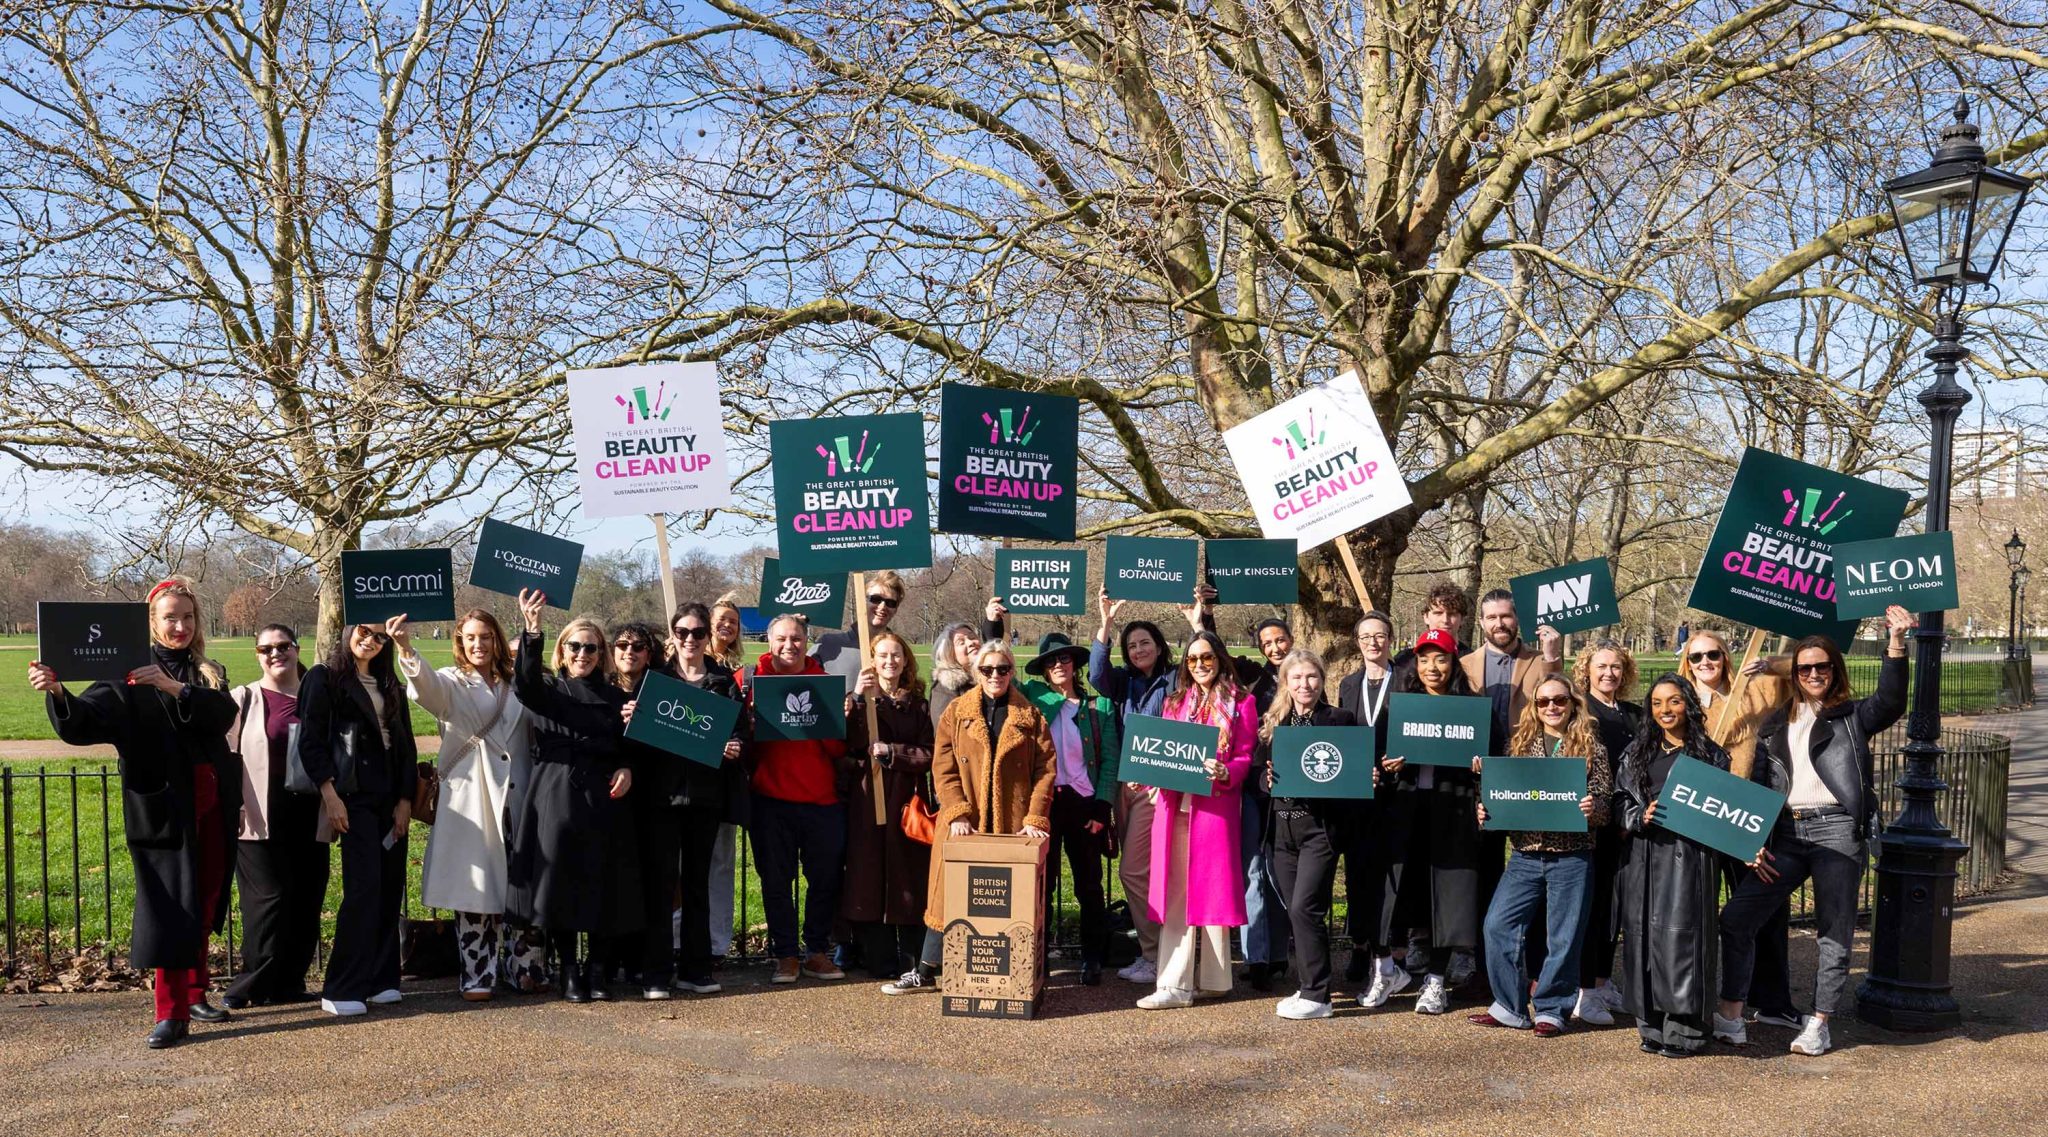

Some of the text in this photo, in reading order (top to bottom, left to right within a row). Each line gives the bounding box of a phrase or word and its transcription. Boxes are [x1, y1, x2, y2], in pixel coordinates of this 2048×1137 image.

[626, 428, 654, 436] GREAT
[605, 434, 696, 458] BEAUTY
[1017, 452, 1049, 460] BRITISH
[596, 454, 711, 479] CLEAN UP
[966, 456, 1052, 480] BEAUTY
[1274, 446, 1358, 499] BEAUTY
[859, 479, 894, 487] BRITISH
[955, 475, 1062, 501] CLEAN UP
[1273, 476, 1348, 520] CLEAN
[1348, 461, 1378, 486] UP
[804, 488, 899, 511] BEAUTY
[793, 508, 912, 533] CLEAN UP
[1296, 514, 1327, 532] SUSTAINABLE
[1328, 506, 1347, 516] BEAUTY
[1347, 494, 1374, 508] COALITION
[1754, 523, 1832, 552] THE GREAT BRIT
[1138, 558, 1165, 568] BAIE
[1742, 532, 1834, 578] BEAUT
[515, 565, 546, 577] PROVENCE
[1011, 560, 1070, 572] BRITISH
[1244, 568, 1295, 576] KINGSLEY
[1846, 555, 1942, 586] NEOM
[354, 568, 442, 592] scrummi
[1120, 569, 1183, 581] BOTANIQUE
[1723, 551, 1837, 603] CLEAN U
[775, 577, 830, 606] Boots
[1011, 577, 1070, 590] BEAUTY
[1848, 581, 1943, 596] WELLBEING LONDON
[1537, 573, 1592, 616] MY
[1751, 586, 1782, 598] POWERED
[1010, 594, 1070, 607] COUNCIL
[1730, 586, 1823, 620] SUSTAINABLE BEAUTY COALITION
[1536, 604, 1600, 624] MYGROUP
[781, 712, 818, 724] Earthy
[1403, 722, 1474, 740] BRAIDS GANG
[1132, 735, 1206, 762] MZ SKIN
[1325, 746, 1339, 760] YARD
[1151, 759, 1178, 769] MARYAM
[1178, 763, 1203, 774] ZAMANI
[1306, 766, 1338, 779] REMEDIES
[1671, 784, 1764, 833] ELEMIS
[973, 879, 1007, 887] BRITISH
[973, 898, 1006, 906] COUNCIL
[972, 939, 1005, 947] RECYCLE
[972, 948, 994, 956] YOUR
[972, 956, 1001, 964] BEAUTY
